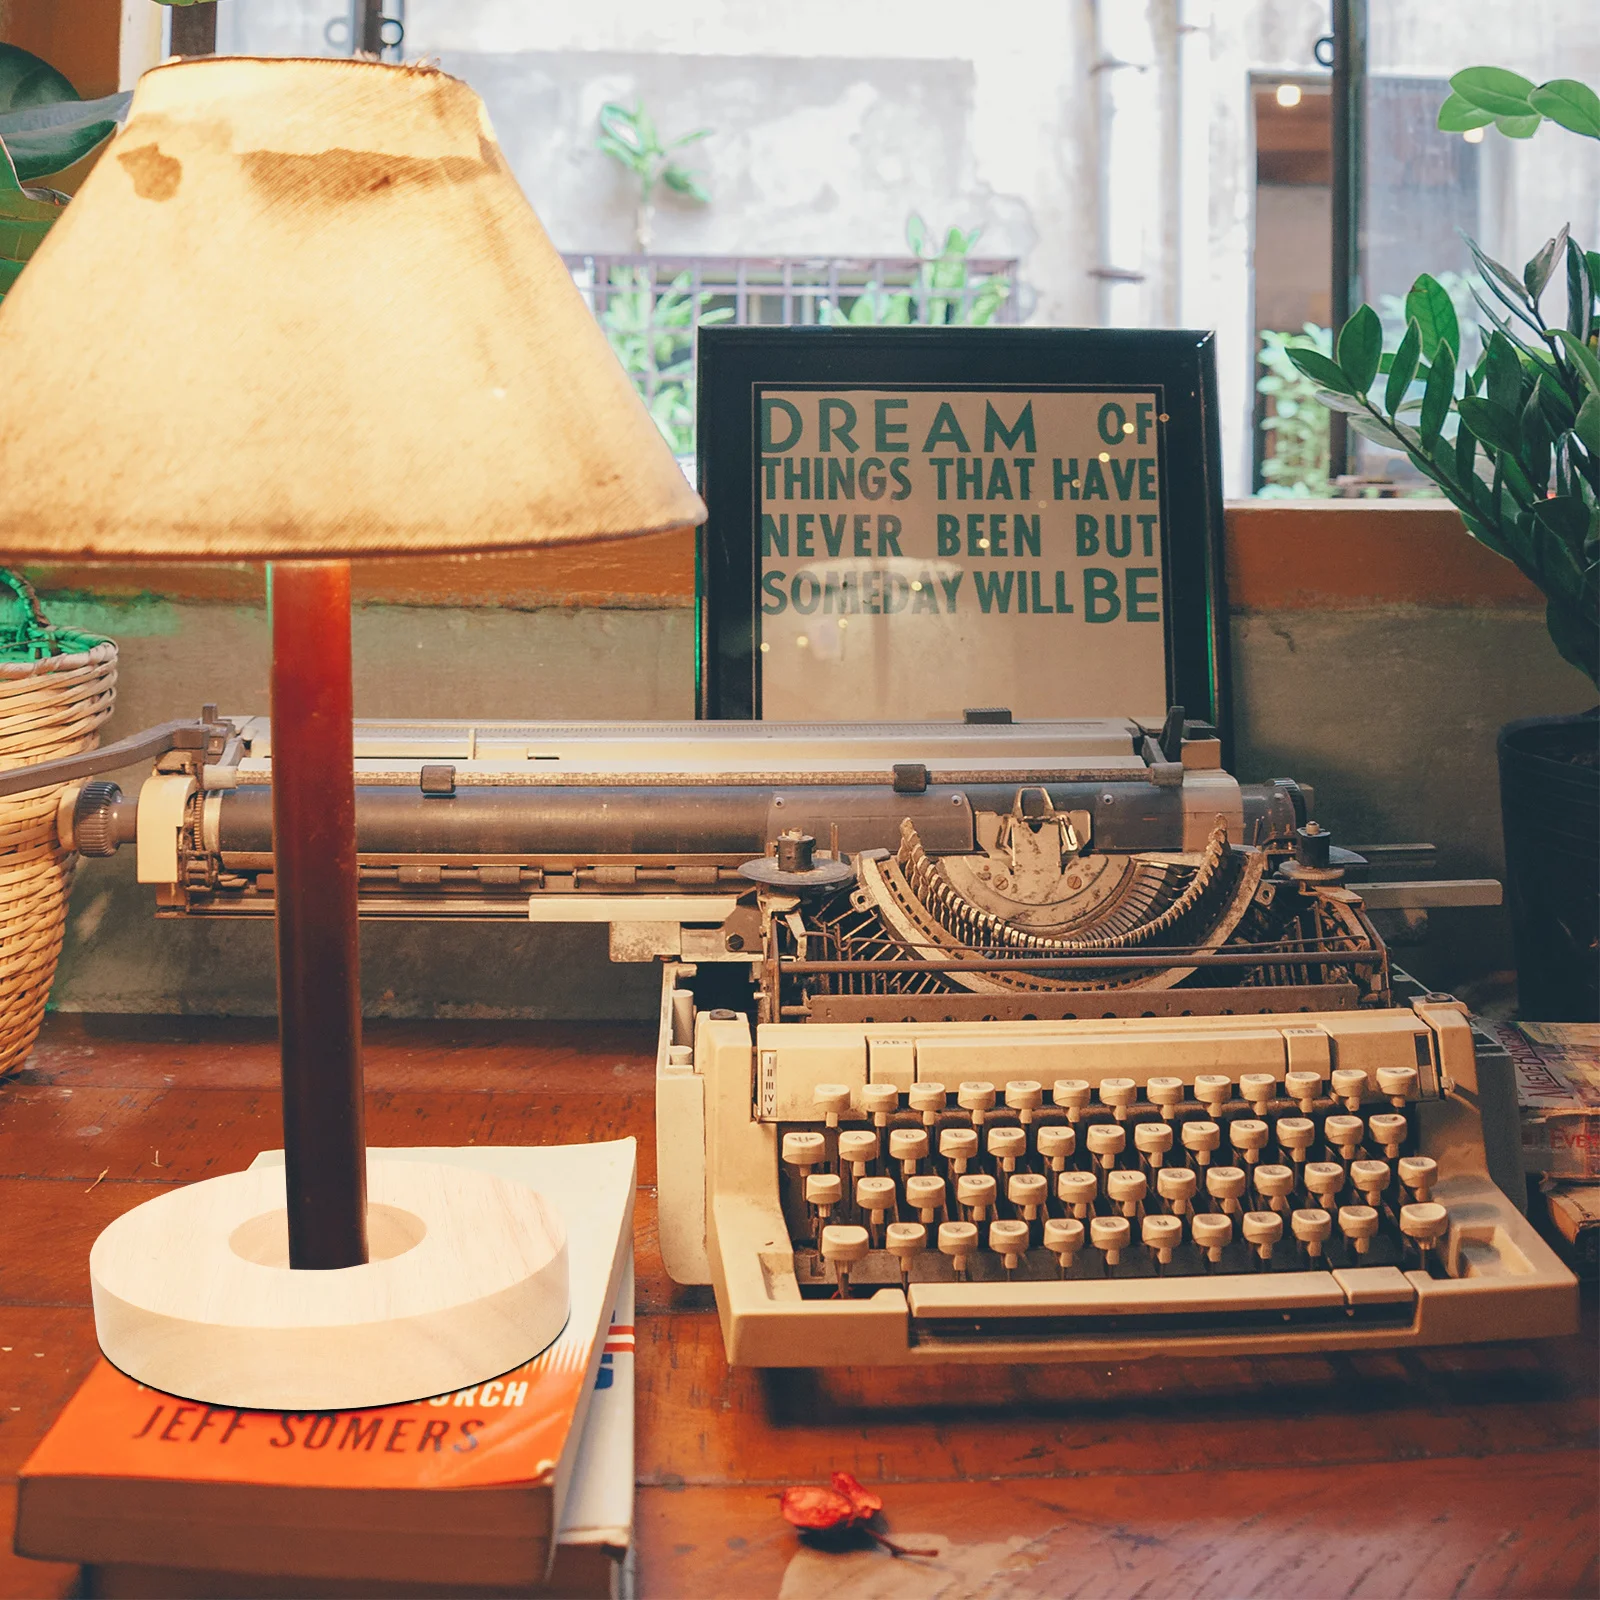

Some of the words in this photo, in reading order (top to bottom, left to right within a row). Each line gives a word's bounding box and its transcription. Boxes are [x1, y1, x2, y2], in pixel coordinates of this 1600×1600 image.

[761, 398, 1037, 453] DREAM
[1097, 402, 1153, 445] OF
[761, 457, 912, 501] THINGS
[929, 457, 1035, 500] THAT
[1053, 458, 1157, 501] HAVE
[761, 514, 903, 557] NEVER
[937, 514, 1041, 557] BEEN
[1076, 514, 1158, 558] BUT
[761, 570, 965, 615] SOMEDAY
[973, 570, 1074, 614] WILL
[1084, 567, 1160, 624] BE
[767, 1069, 773, 1077] II
[768, 1056, 772, 1064] I
[764, 1094, 774, 1102] IV
[765, 1081, 774, 1090] III
[766, 1107, 773, 1116] V
[132, 1405, 246, 1443] JEFF
[269, 1412, 484, 1453] SOMERS
